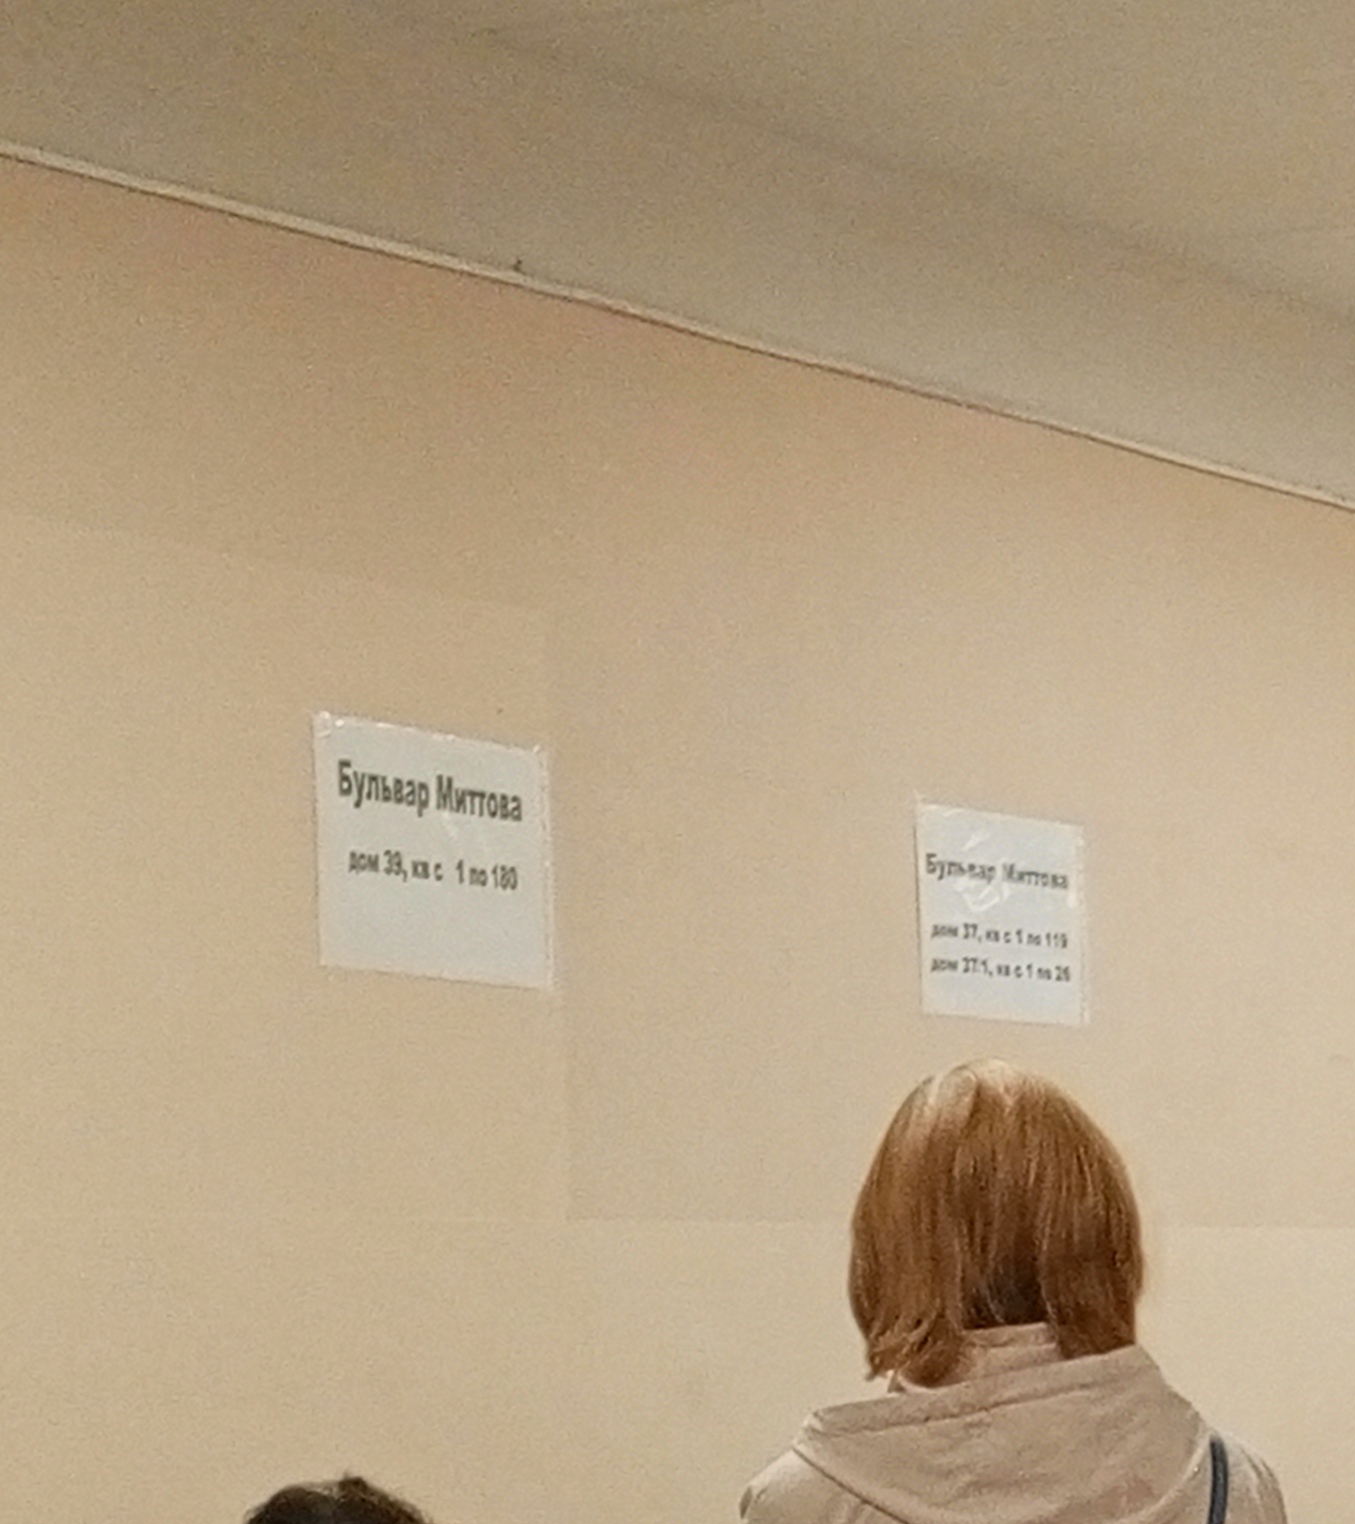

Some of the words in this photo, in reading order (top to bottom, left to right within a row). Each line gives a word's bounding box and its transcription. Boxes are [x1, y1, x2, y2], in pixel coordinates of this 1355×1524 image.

[337, 758, 430, 818] Бульвар
[435, 773, 522, 822] Миттова
[348, 850, 380, 874] дом
[411, 860, 430, 880] кв
[434, 862, 443, 881] с
[456, 859, 464, 884] 1
[469, 867, 488, 888] по
